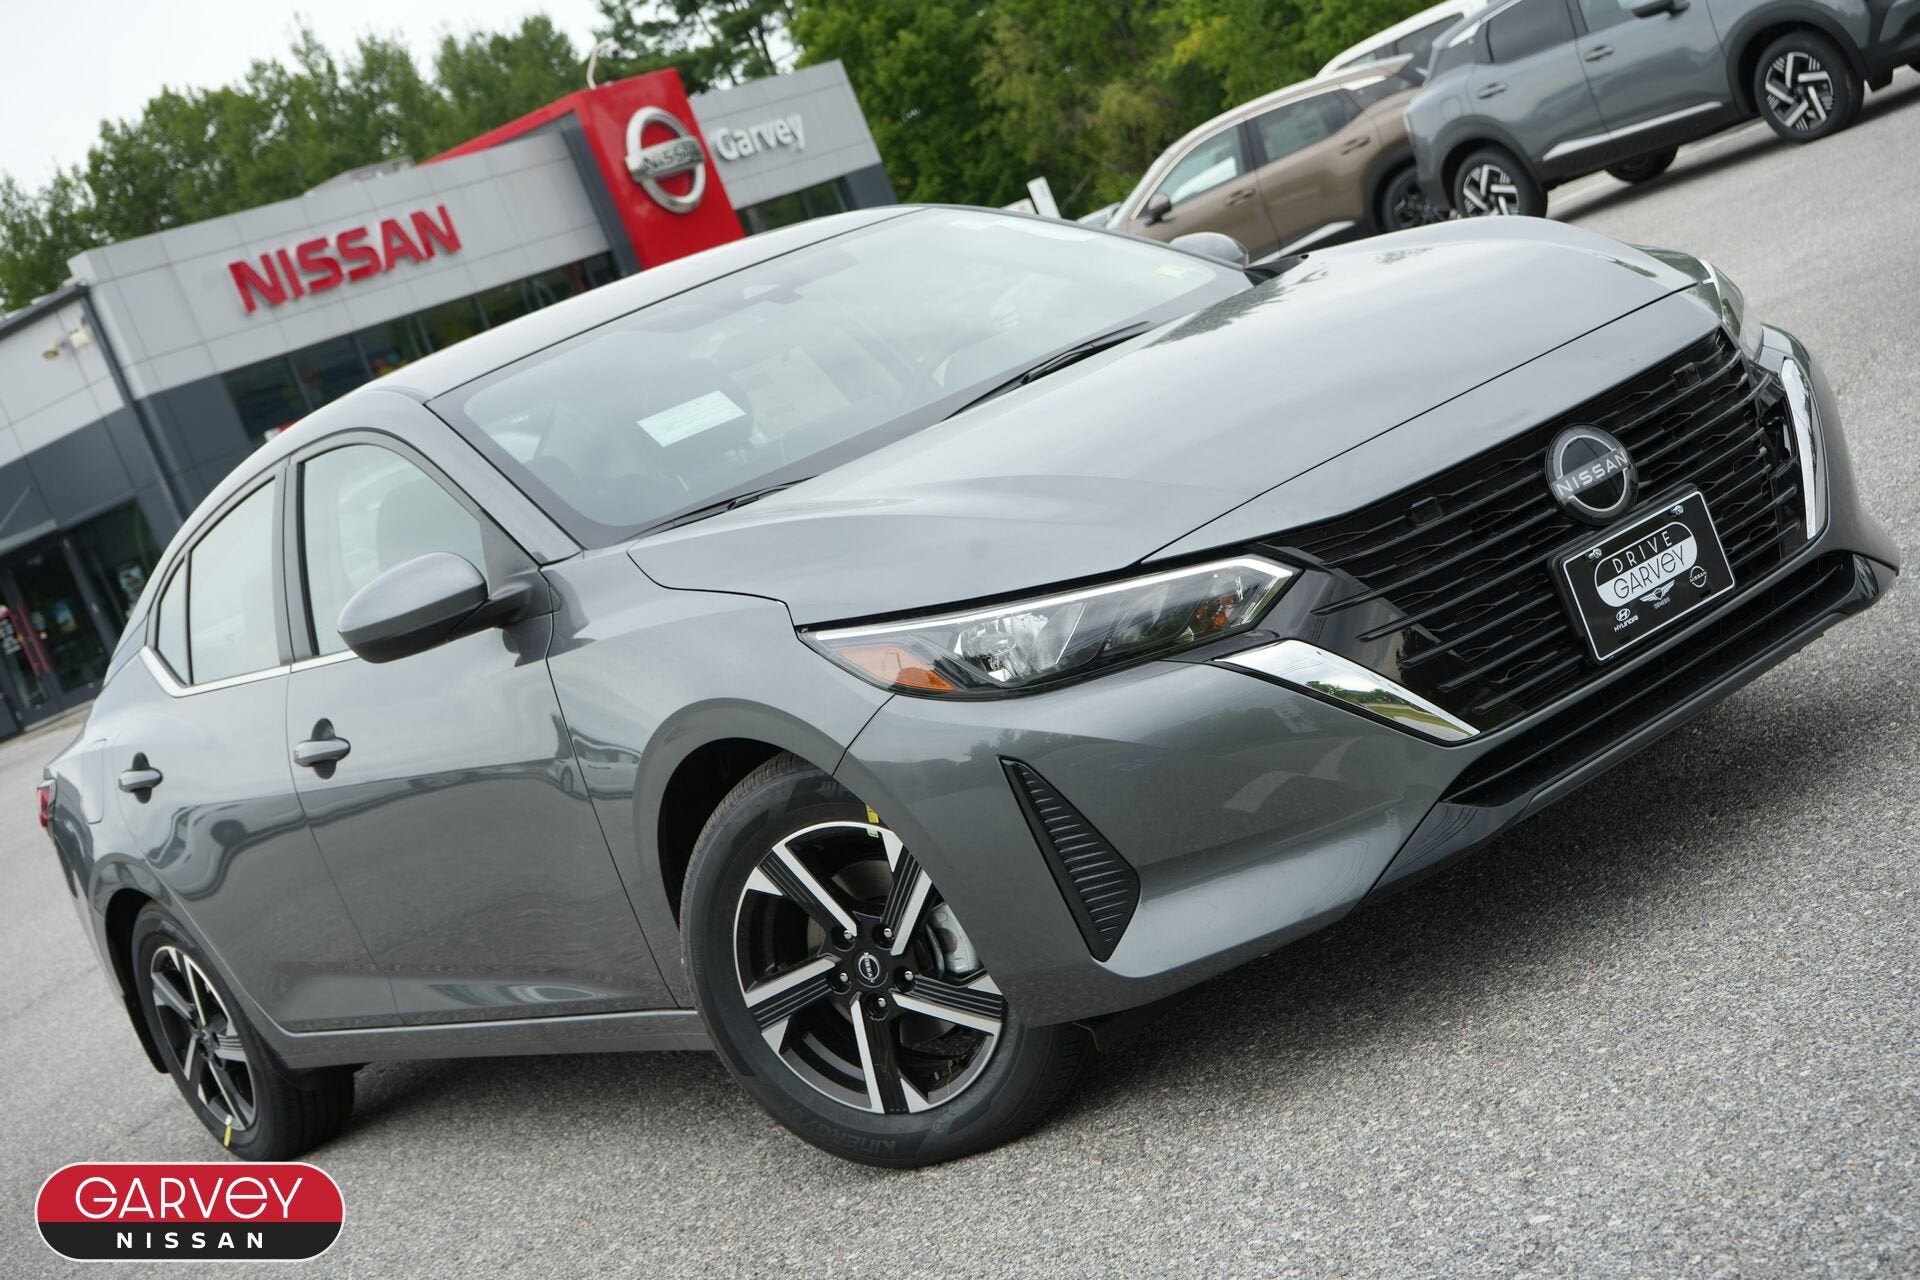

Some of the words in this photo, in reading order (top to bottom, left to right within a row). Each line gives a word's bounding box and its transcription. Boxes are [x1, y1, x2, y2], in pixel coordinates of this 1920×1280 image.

[715, 113, 806, 162] Garvey
[228, 204, 463, 314] NISSAN
[1556, 452, 1629, 497] NISSAN
[1612, 530, 1674, 573] DRIVE
